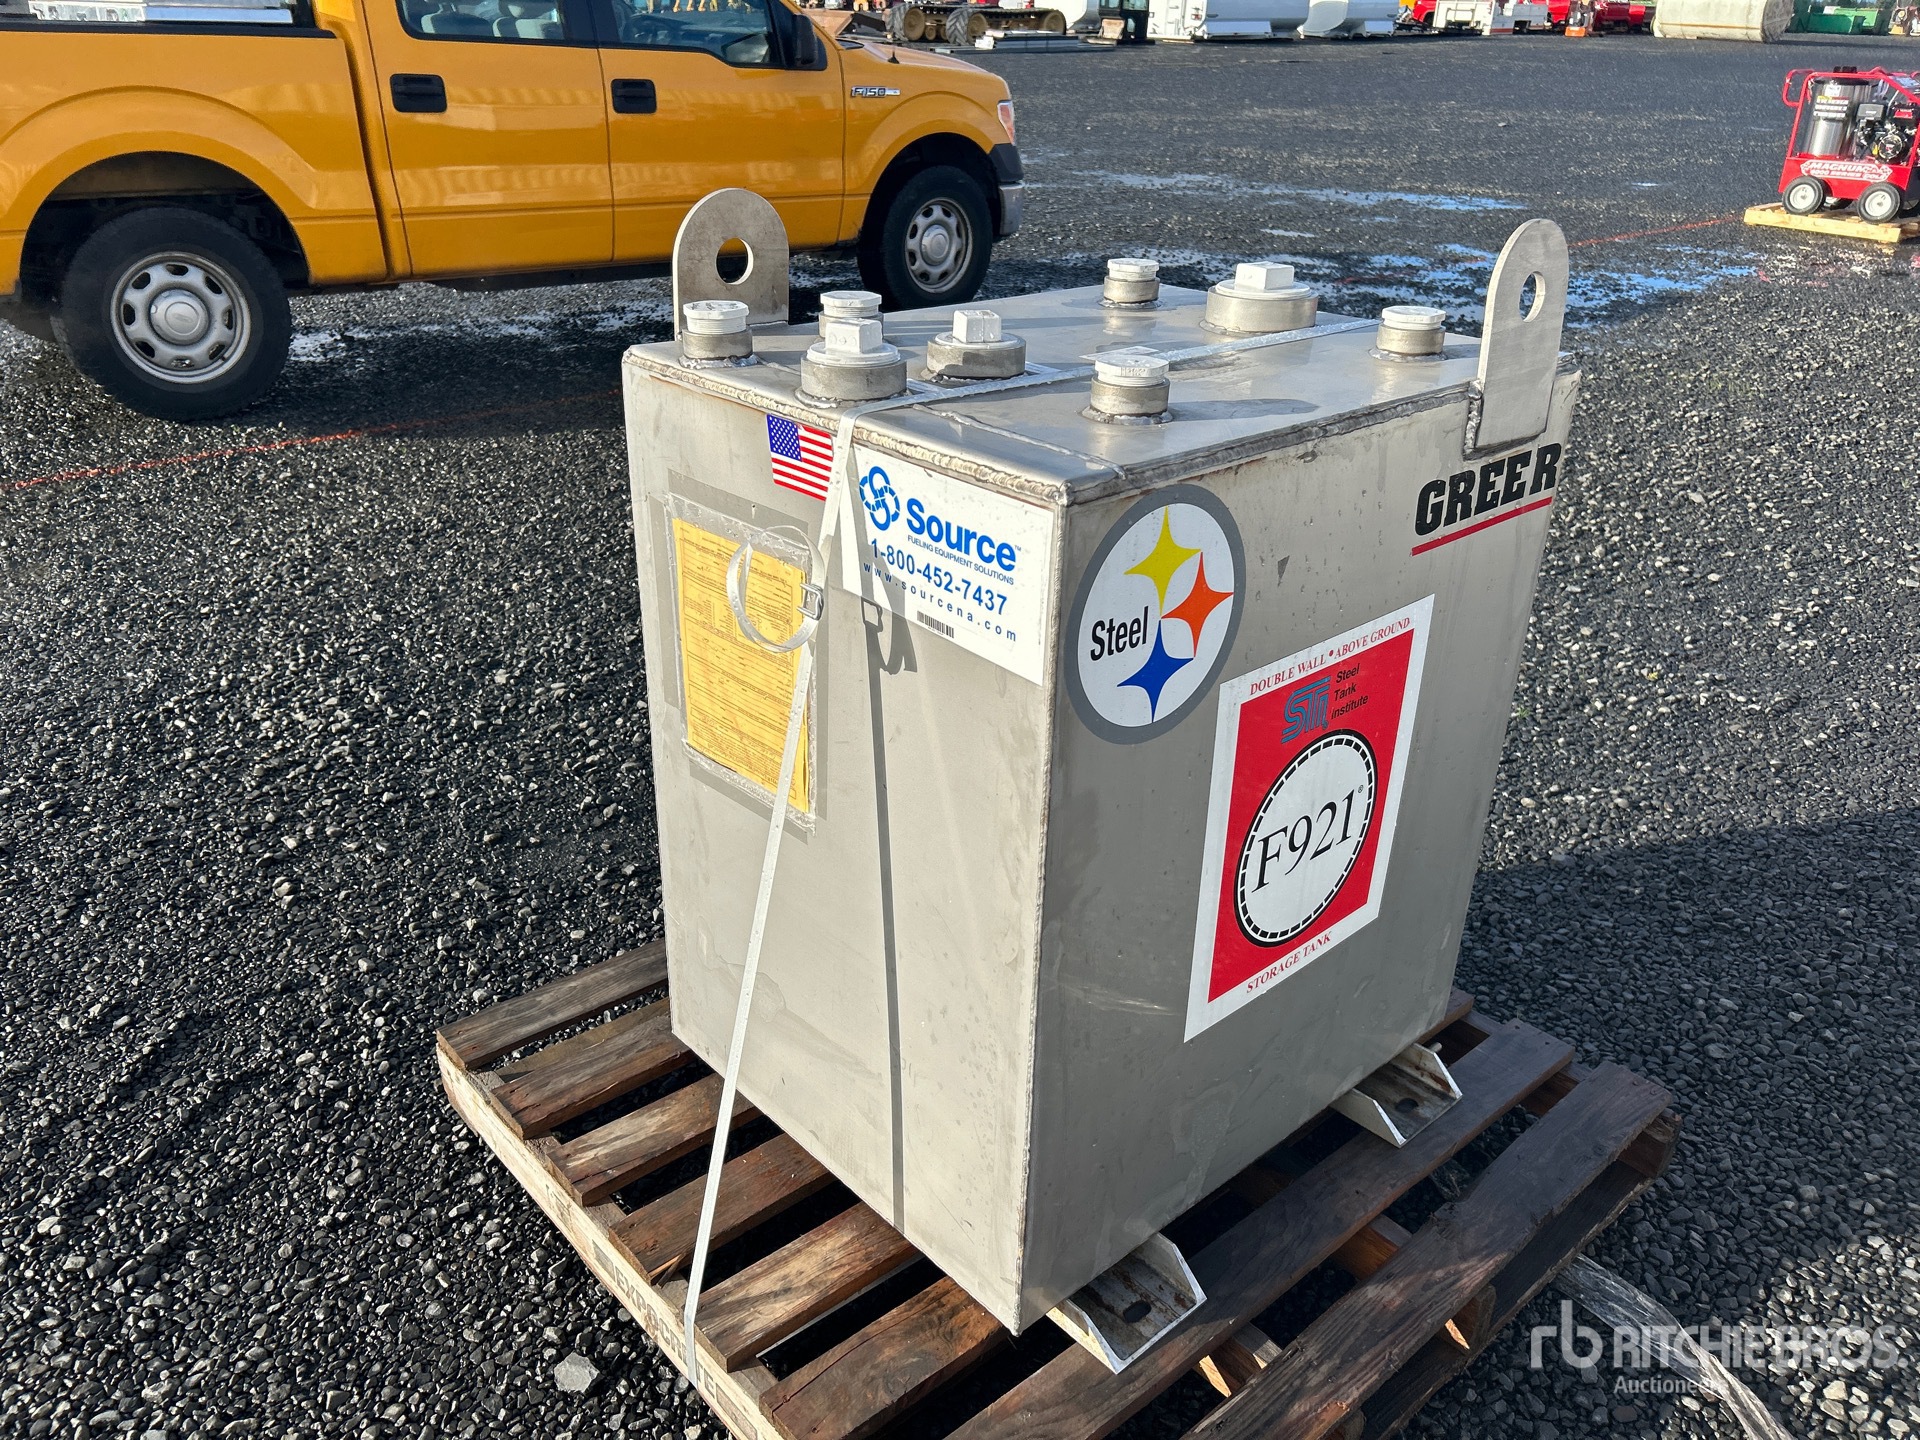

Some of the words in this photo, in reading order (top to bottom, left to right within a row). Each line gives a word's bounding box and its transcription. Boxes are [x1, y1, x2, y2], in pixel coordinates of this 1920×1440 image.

[1809, 162, 1866, 172] MAGNUM
[1415, 443, 1562, 536] GREER
[871, 538, 1008, 615] 1-800-452-7437
[907, 535, 934, 553] FUELING
[934, 546, 973, 569] EQUIPMENT
[974, 563, 1015, 586] SOLUTIONS
[863, 562, 1017, 642] www.sourcena.com
[1090, 606, 1148, 661] Steel
[1250, 666, 1295, 696] DOUBLE
[1297, 654, 1327, 675] WALL
[1334, 637, 1369, 659] ABOVE
[1370, 617, 1411, 647] GROUND
[1334, 683, 1357, 701] Tank
[1335, 663, 1361, 684] Steel
[1247, 952, 1301, 995] STORAGE
[1303, 930, 1332, 964] TANK
